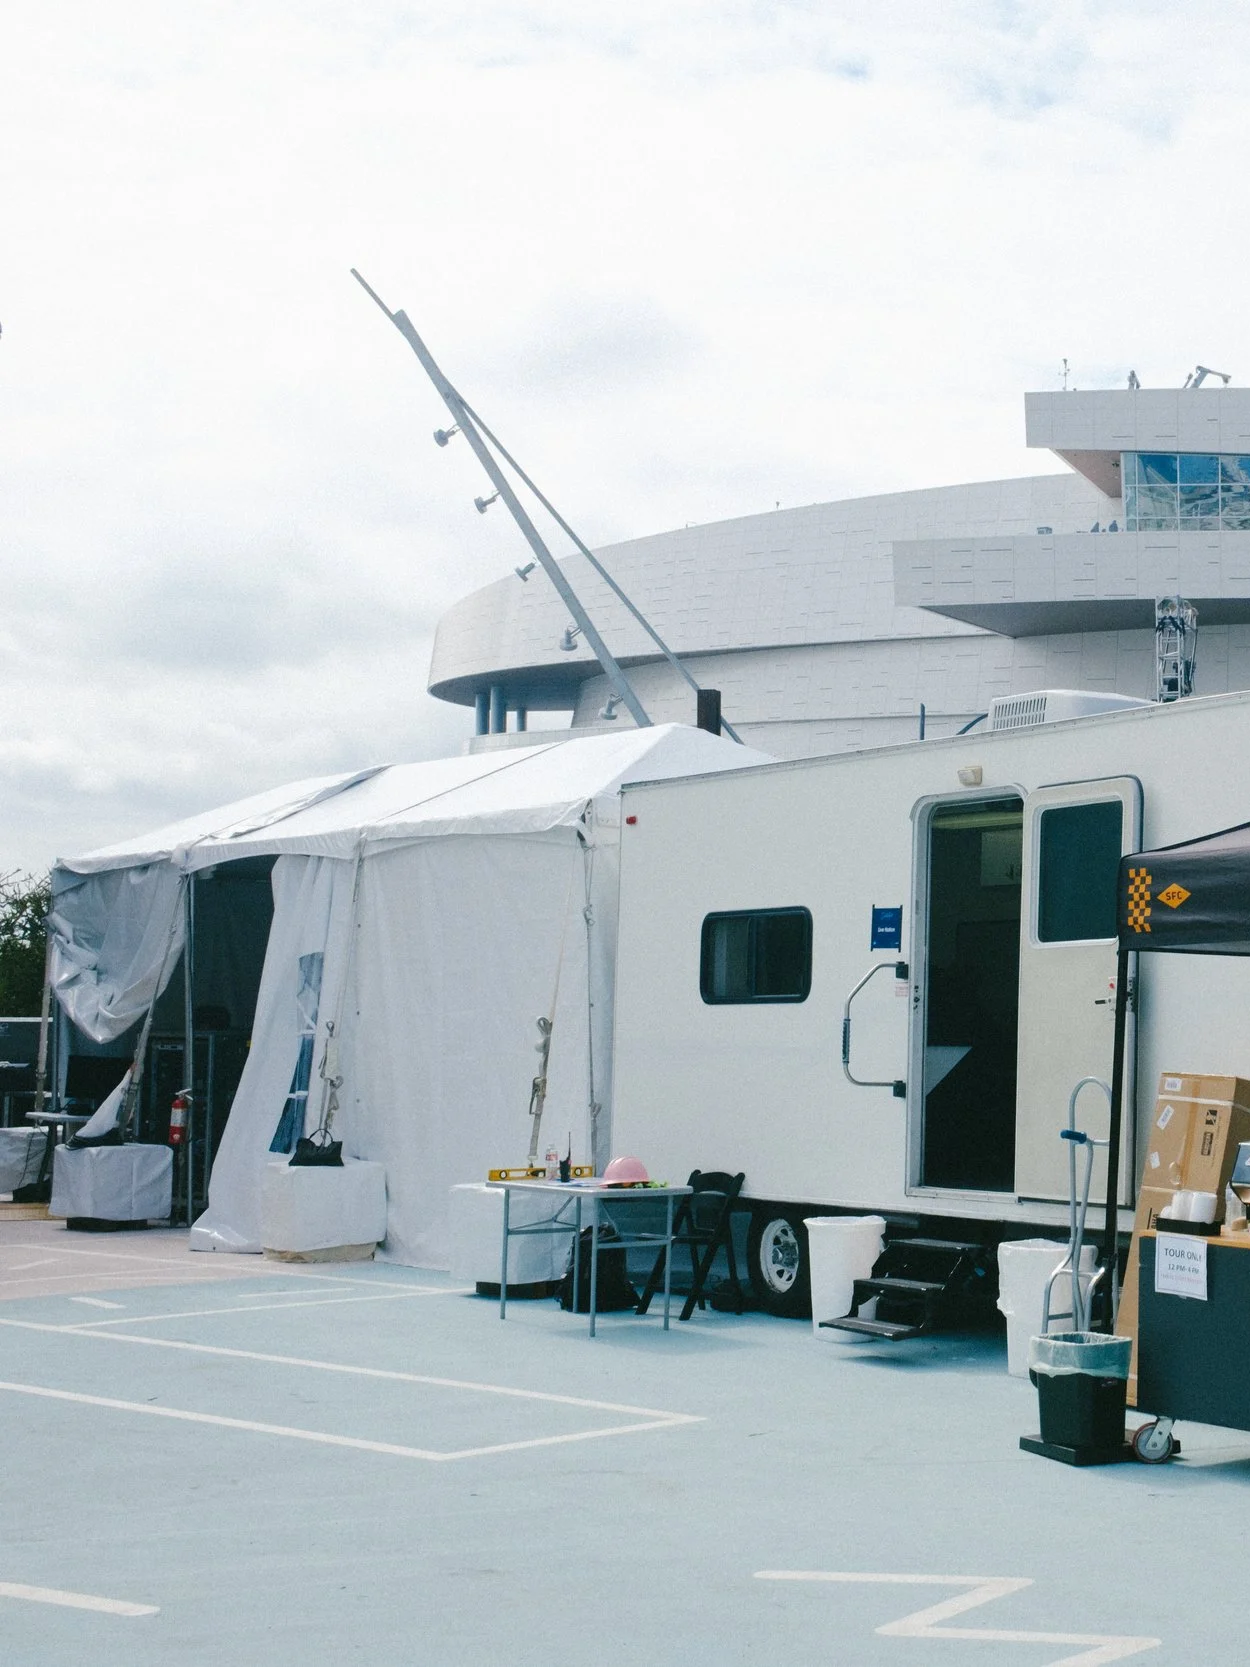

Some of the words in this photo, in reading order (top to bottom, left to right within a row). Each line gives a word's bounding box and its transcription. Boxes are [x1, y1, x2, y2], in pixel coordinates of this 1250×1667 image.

[1165, 891, 1183, 901] SFC
[1164, 1248, 1186, 1259] TOUR
[1168, 1263, 1175, 1271] 12
